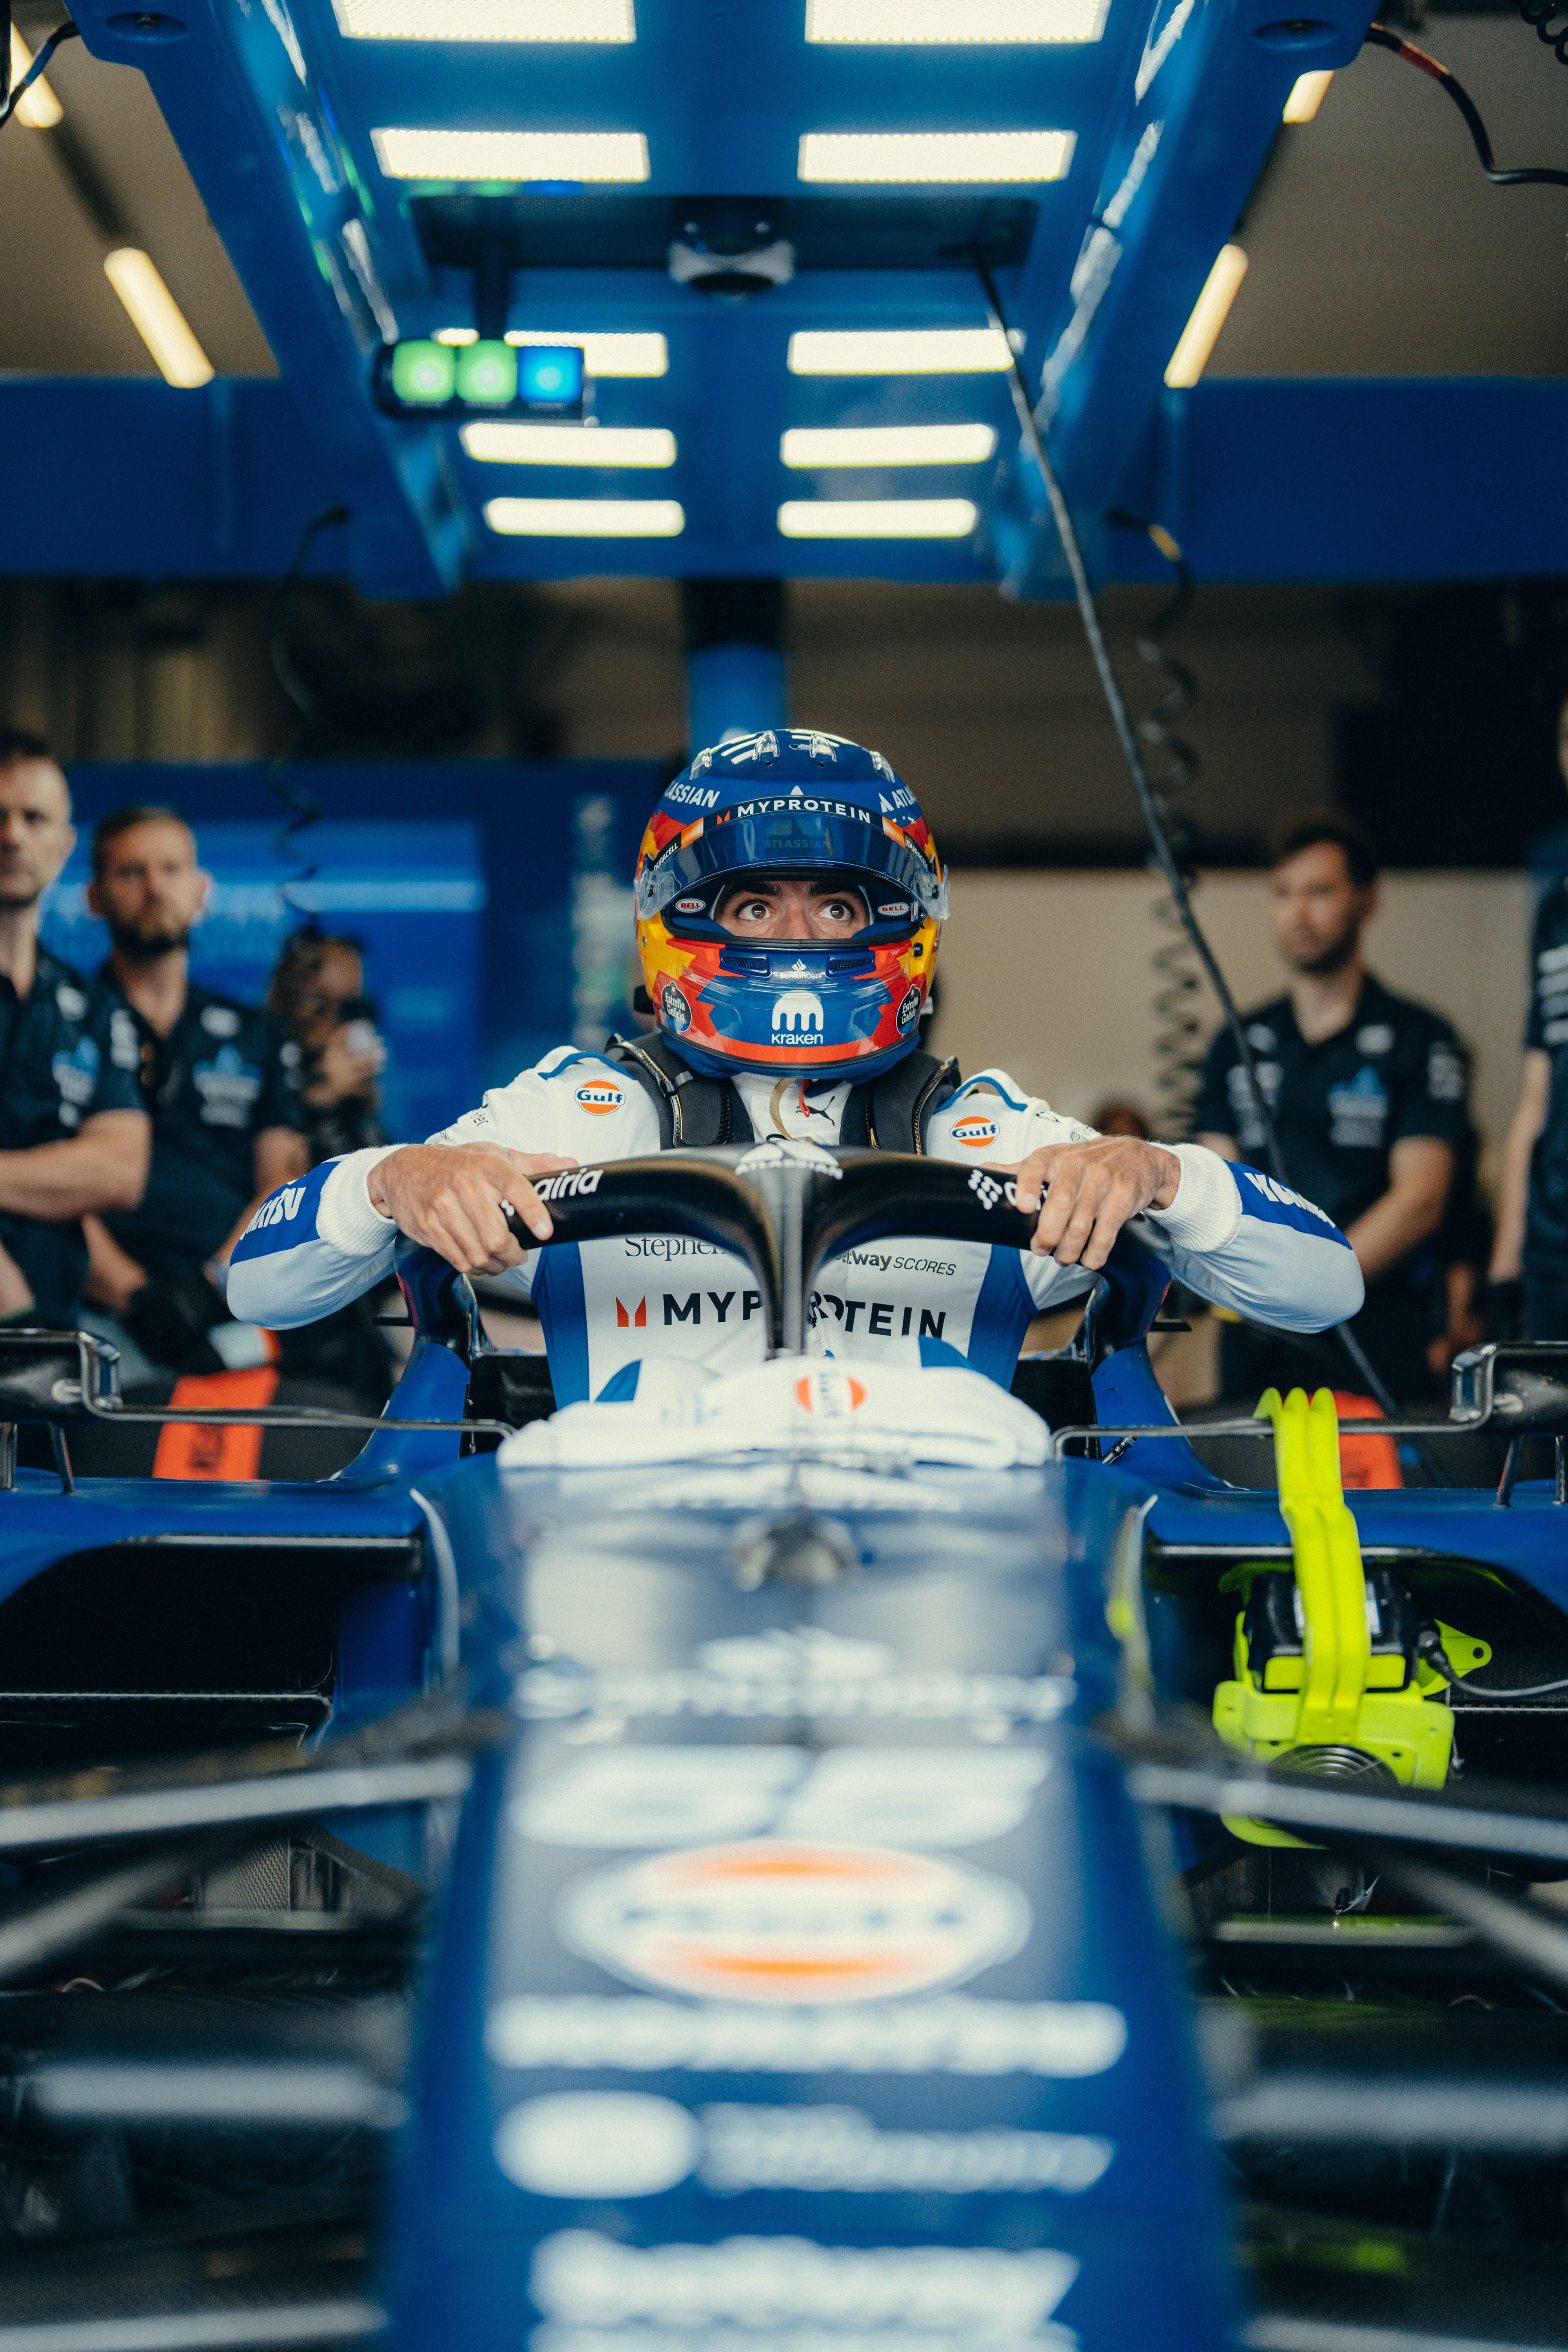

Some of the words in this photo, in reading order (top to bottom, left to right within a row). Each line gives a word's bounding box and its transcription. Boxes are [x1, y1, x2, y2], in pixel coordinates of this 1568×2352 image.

[738, 799, 871, 824] MYPROTEIN
[764, 839, 826, 848] ATLASSIA
[653, 843, 678, 871] DURACELL
[665, 992, 685, 1011] Estrella
[902, 996, 919, 1014] Estrella
[667, 1004, 685, 1022] Galicia
[577, 1090, 623, 1103] Gulf
[952, 1124, 996, 1138] Gulf
[534, 1167, 604, 1201] airia
[893, 1257, 956, 1276] SCORES
